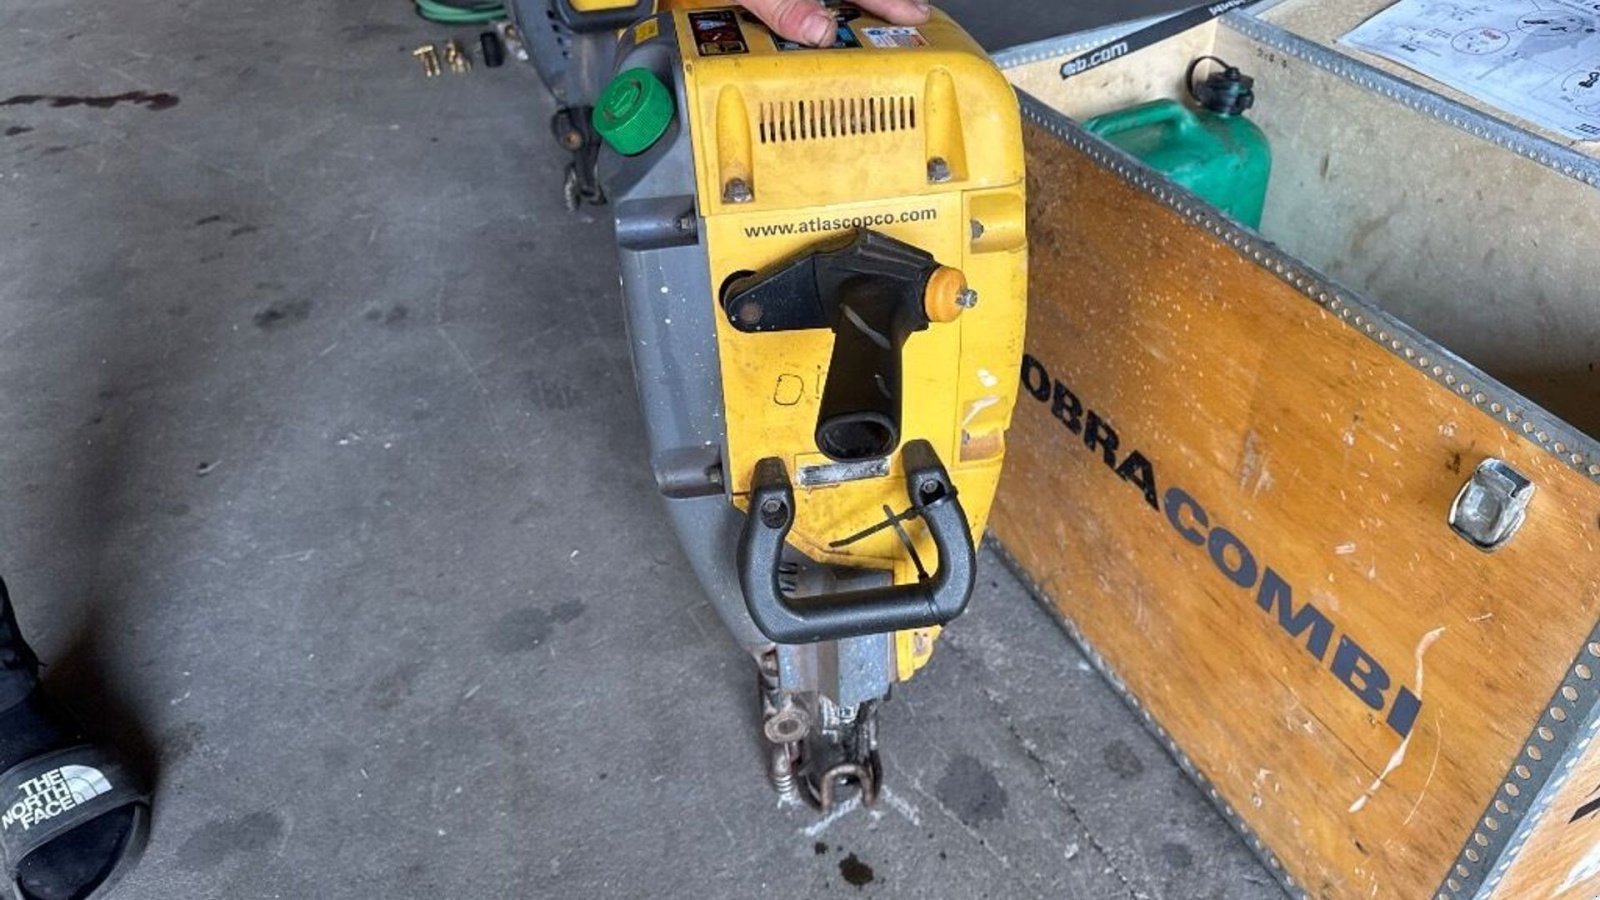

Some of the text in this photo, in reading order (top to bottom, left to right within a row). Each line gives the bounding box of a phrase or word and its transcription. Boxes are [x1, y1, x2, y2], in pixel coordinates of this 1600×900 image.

[744, 207, 938, 238] www.atlascopco.com
[18, 768, 63, 797] THE
[1, 782, 72, 830] NORTH
[20, 797, 76, 830] FACE
